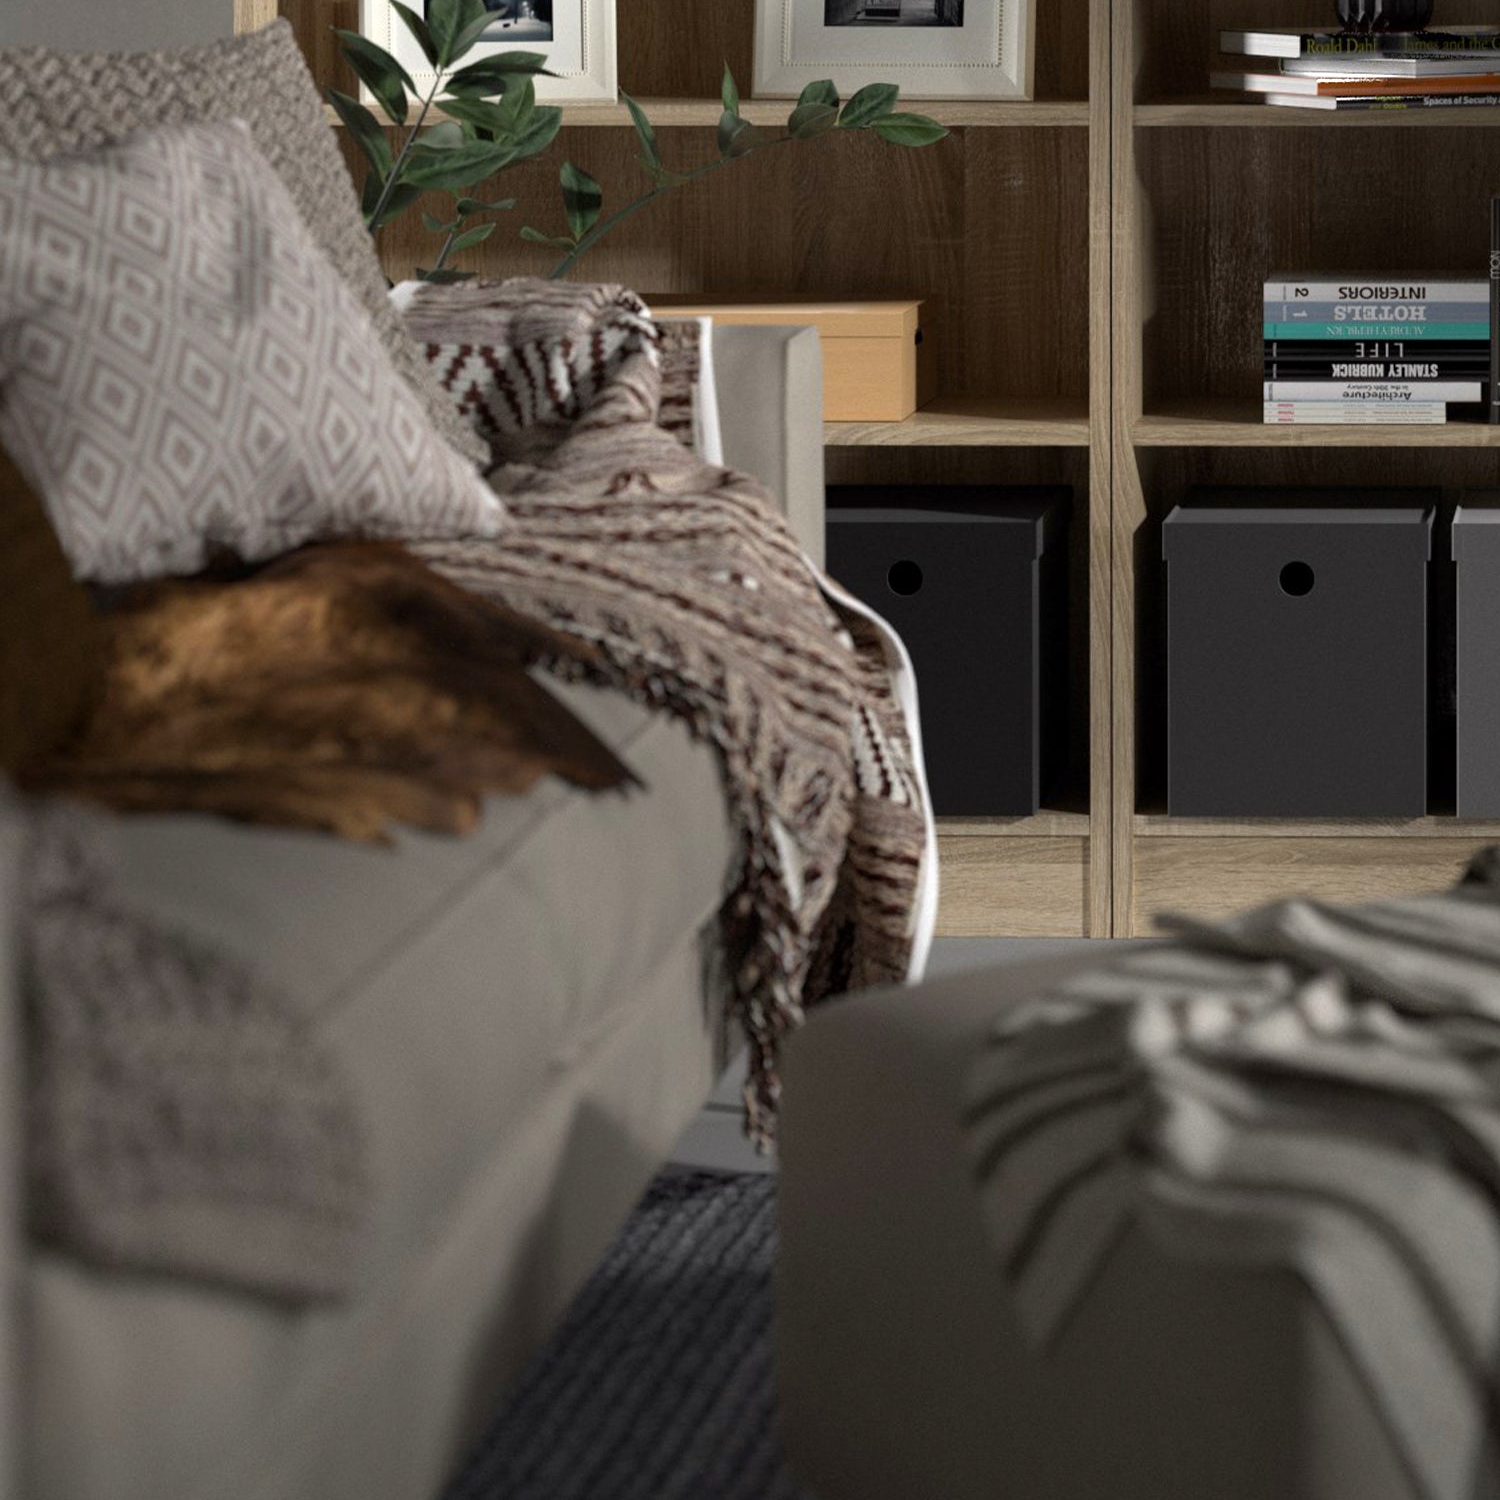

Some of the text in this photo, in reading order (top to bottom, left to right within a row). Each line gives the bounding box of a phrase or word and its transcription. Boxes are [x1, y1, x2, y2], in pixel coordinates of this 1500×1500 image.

[1306, 38, 1377, 54] Roald Dahl
[1443, 37, 1464, 50] and
[1468, 36, 1487, 50] the
[1423, 97, 1452, 106] Spaces
[1454, 97, 1462, 105] of
[1464, 95, 1496, 105] Security
[1490, 250, 1500, 279] NOW
[1295, 288, 1308, 297] 2
[1339, 287, 1426, 299] INTERIORS
[1334, 306, 1426, 321] HOTELS
[1326, 325, 1425, 335] AUDREY HEPBURN
[1355, 342, 1404, 358] LIFE
[1331, 363, 1438, 377] STANLEY KUBRICK
[1343, 391, 1411, 400] Architecture
